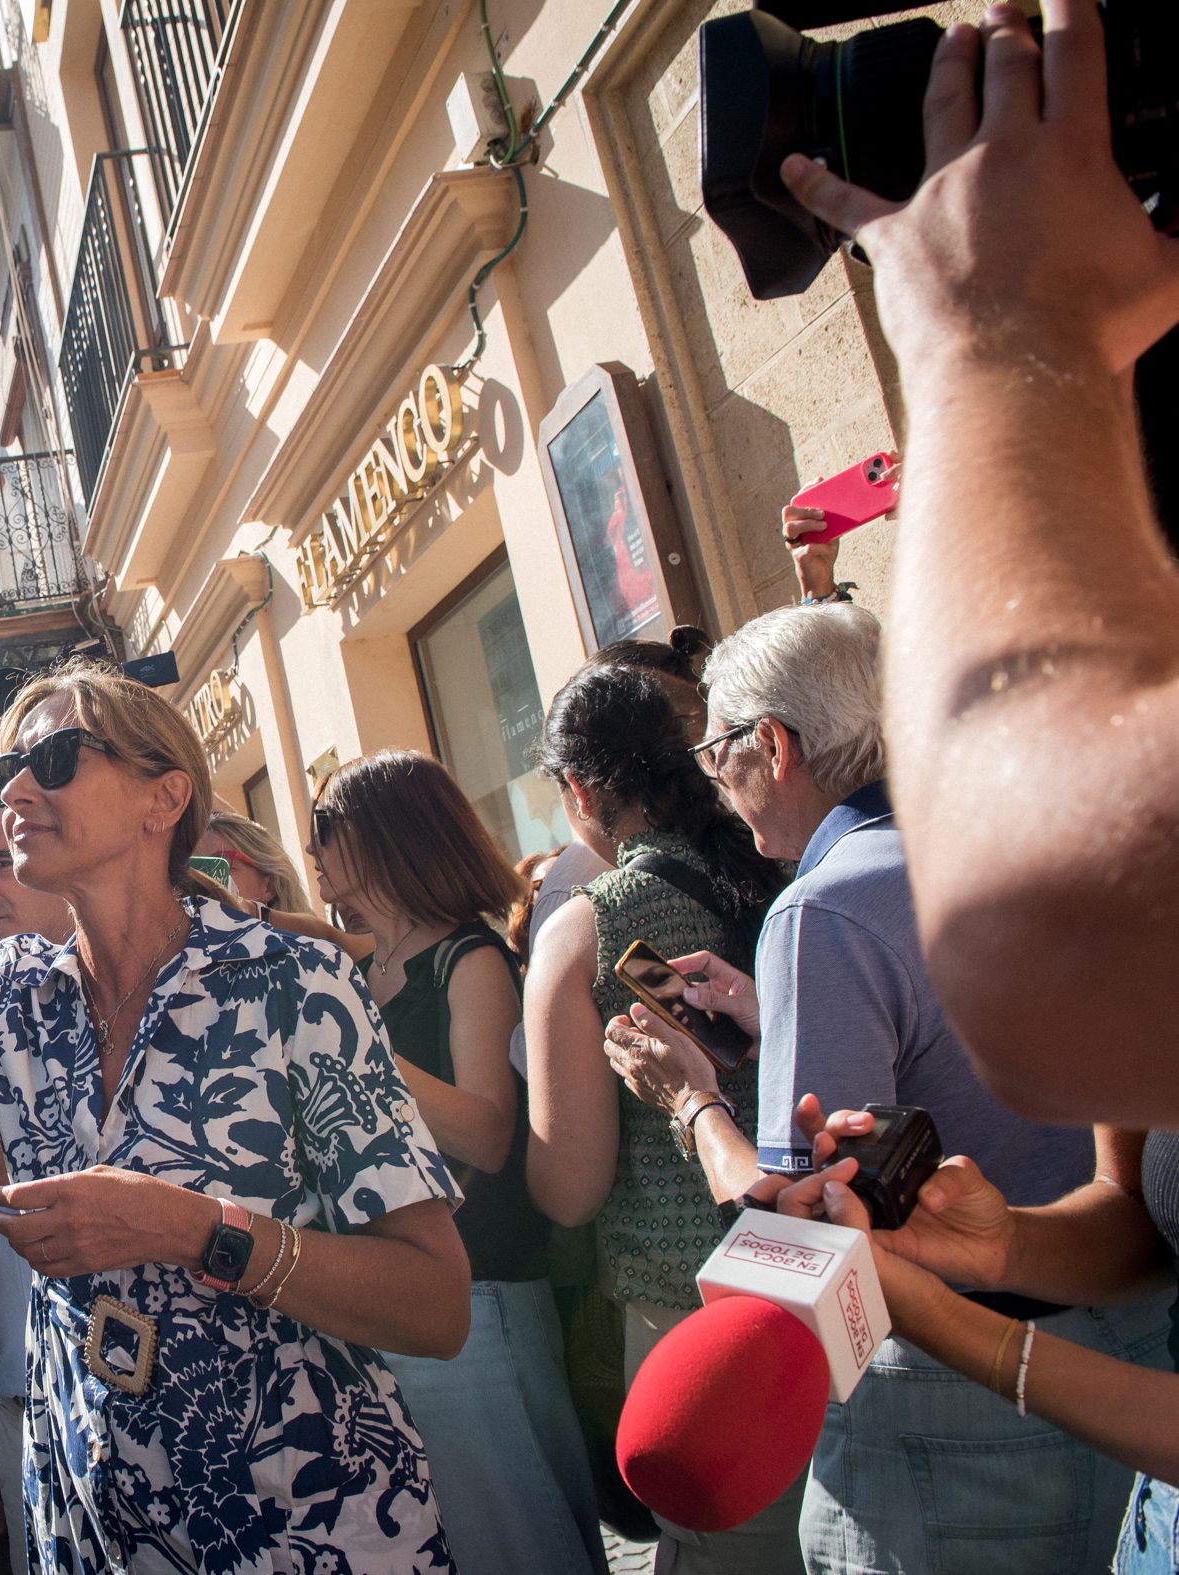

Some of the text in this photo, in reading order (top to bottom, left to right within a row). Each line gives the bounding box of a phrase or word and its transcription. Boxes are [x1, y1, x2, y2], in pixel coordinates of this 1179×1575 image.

[296, 364, 455, 615] FLAMENCO
[501, 709, 544, 742] flamenc
[739, 1239, 815, 1261] DE TODOS
[753, 1250, 820, 1272] EN BOCA
[845, 1303, 865, 1358] EN BOCA
[846, 1280, 868, 1343] DE TODOS
